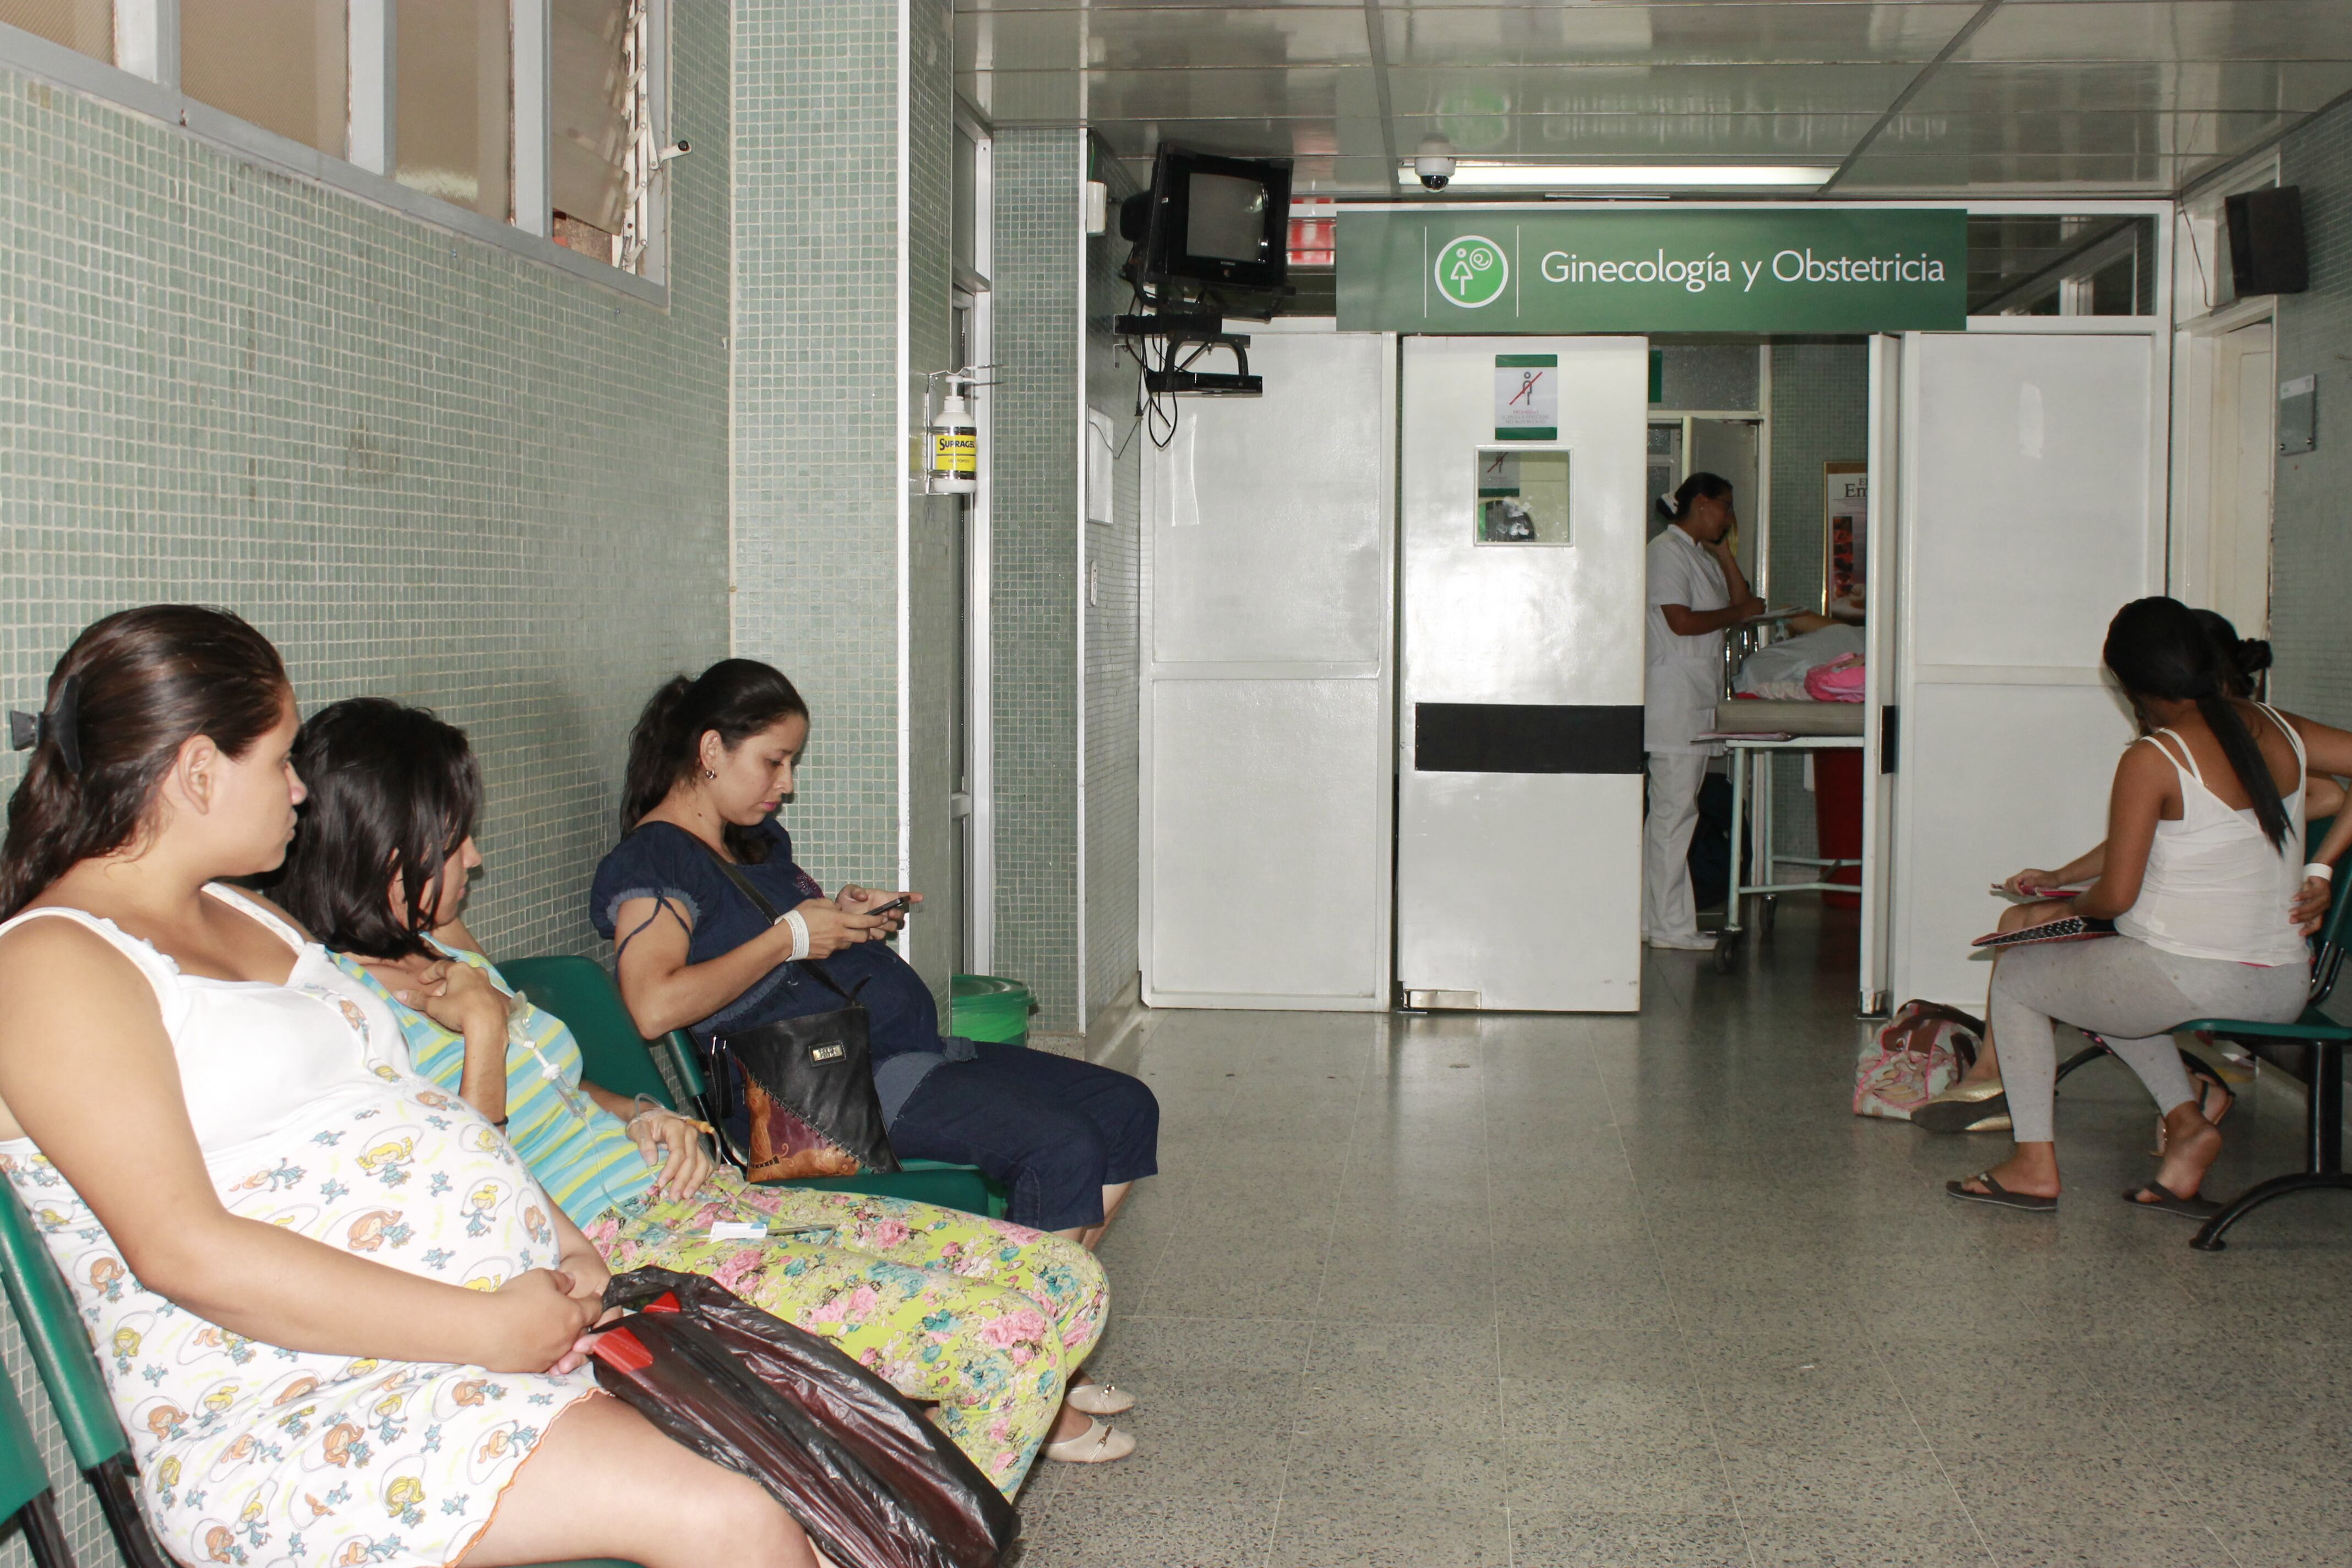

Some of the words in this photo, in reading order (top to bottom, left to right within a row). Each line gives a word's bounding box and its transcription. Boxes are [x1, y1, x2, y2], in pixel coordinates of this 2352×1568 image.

[1541, 248, 1732, 292] Ginecología
[1741, 261, 1763, 292] y
[1772, 249, 1945, 282] Obstetricia
[939, 438, 975, 450] SUPRAGEL
